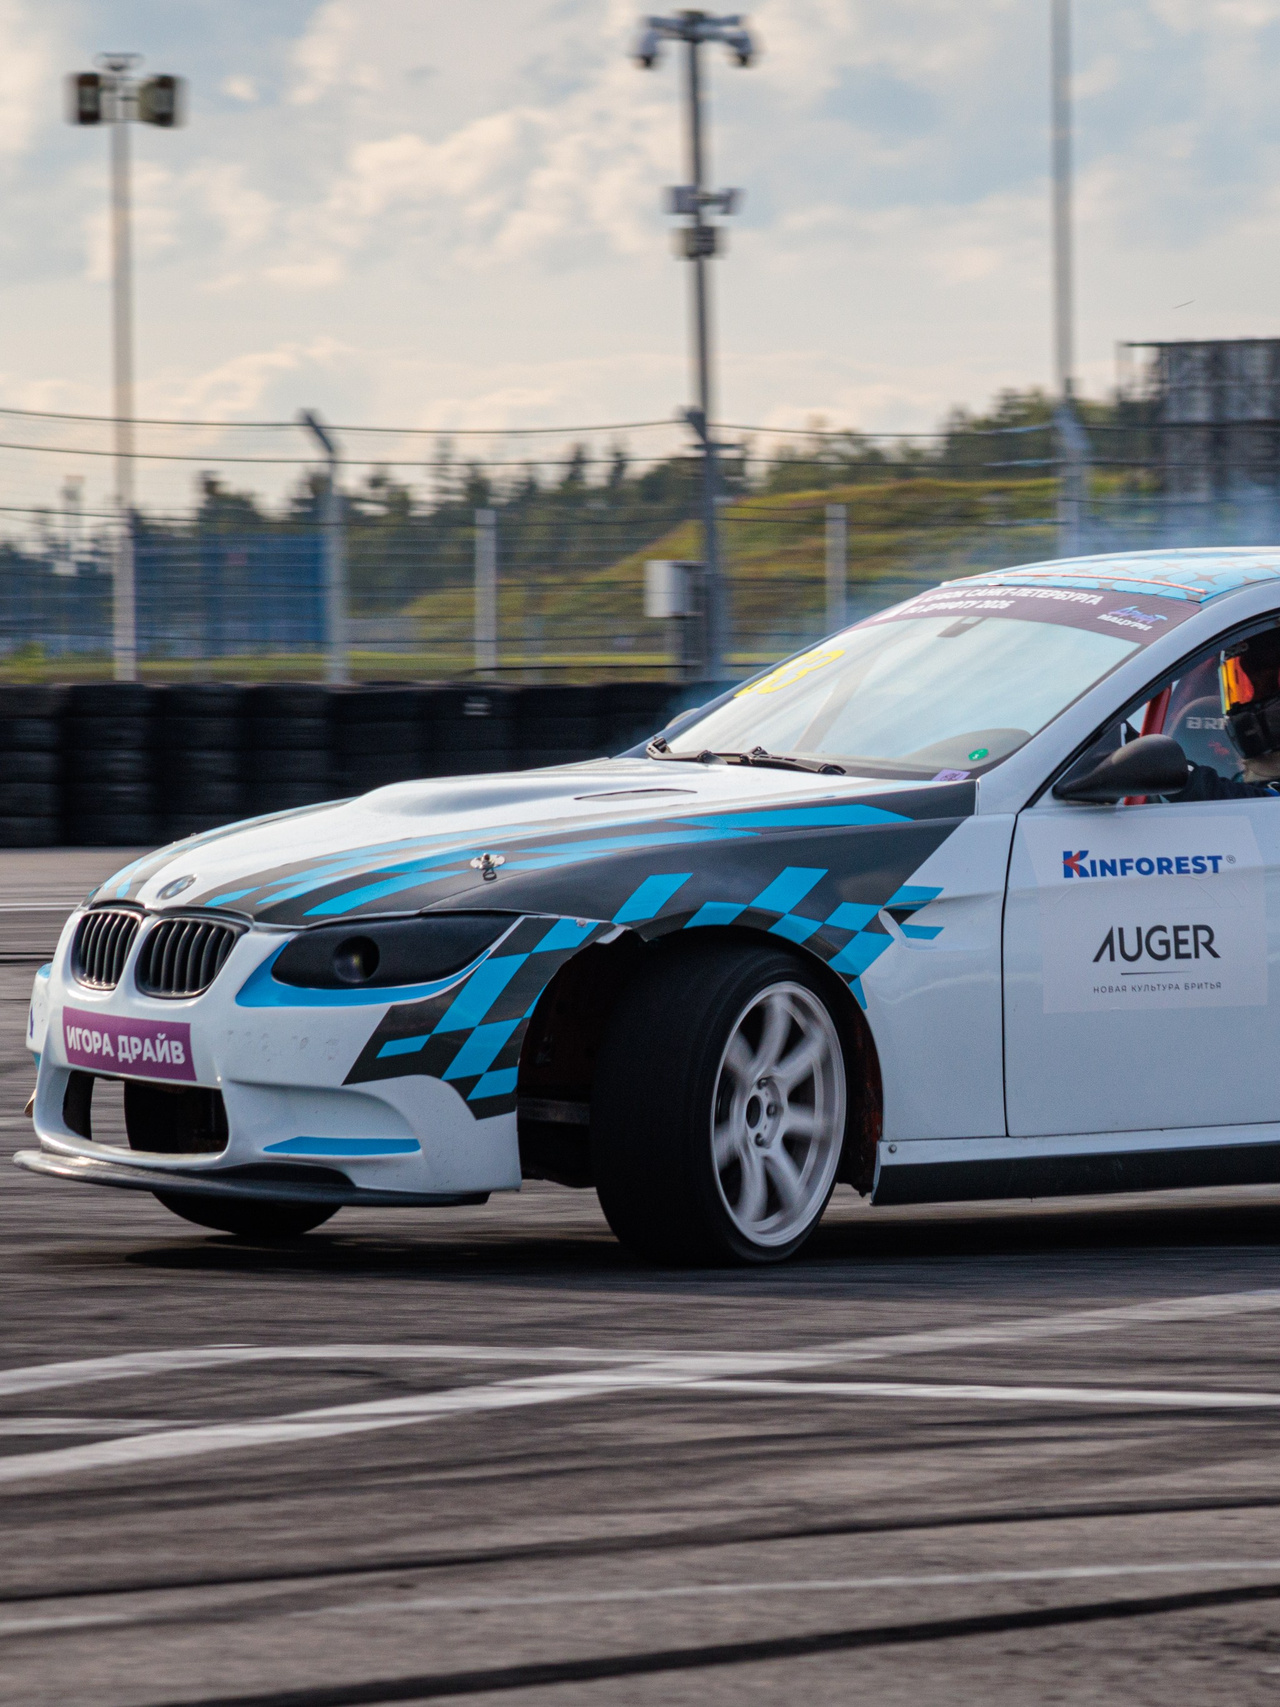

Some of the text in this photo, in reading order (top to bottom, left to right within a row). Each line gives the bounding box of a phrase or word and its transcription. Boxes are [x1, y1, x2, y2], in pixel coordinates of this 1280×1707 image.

[964, 587, 1104, 605] САНКТ-ПЕТЕРБУРГА
[1096, 613, 1153, 631] МАЦУРИ
[1092, 924, 1221, 963] AUGER
[1093, 981, 1222, 994] НОВАЯ КУЛЬТУРА БРИТЬЯ
[66, 1025, 185, 1065] ИГОРА ДРАЙВ
